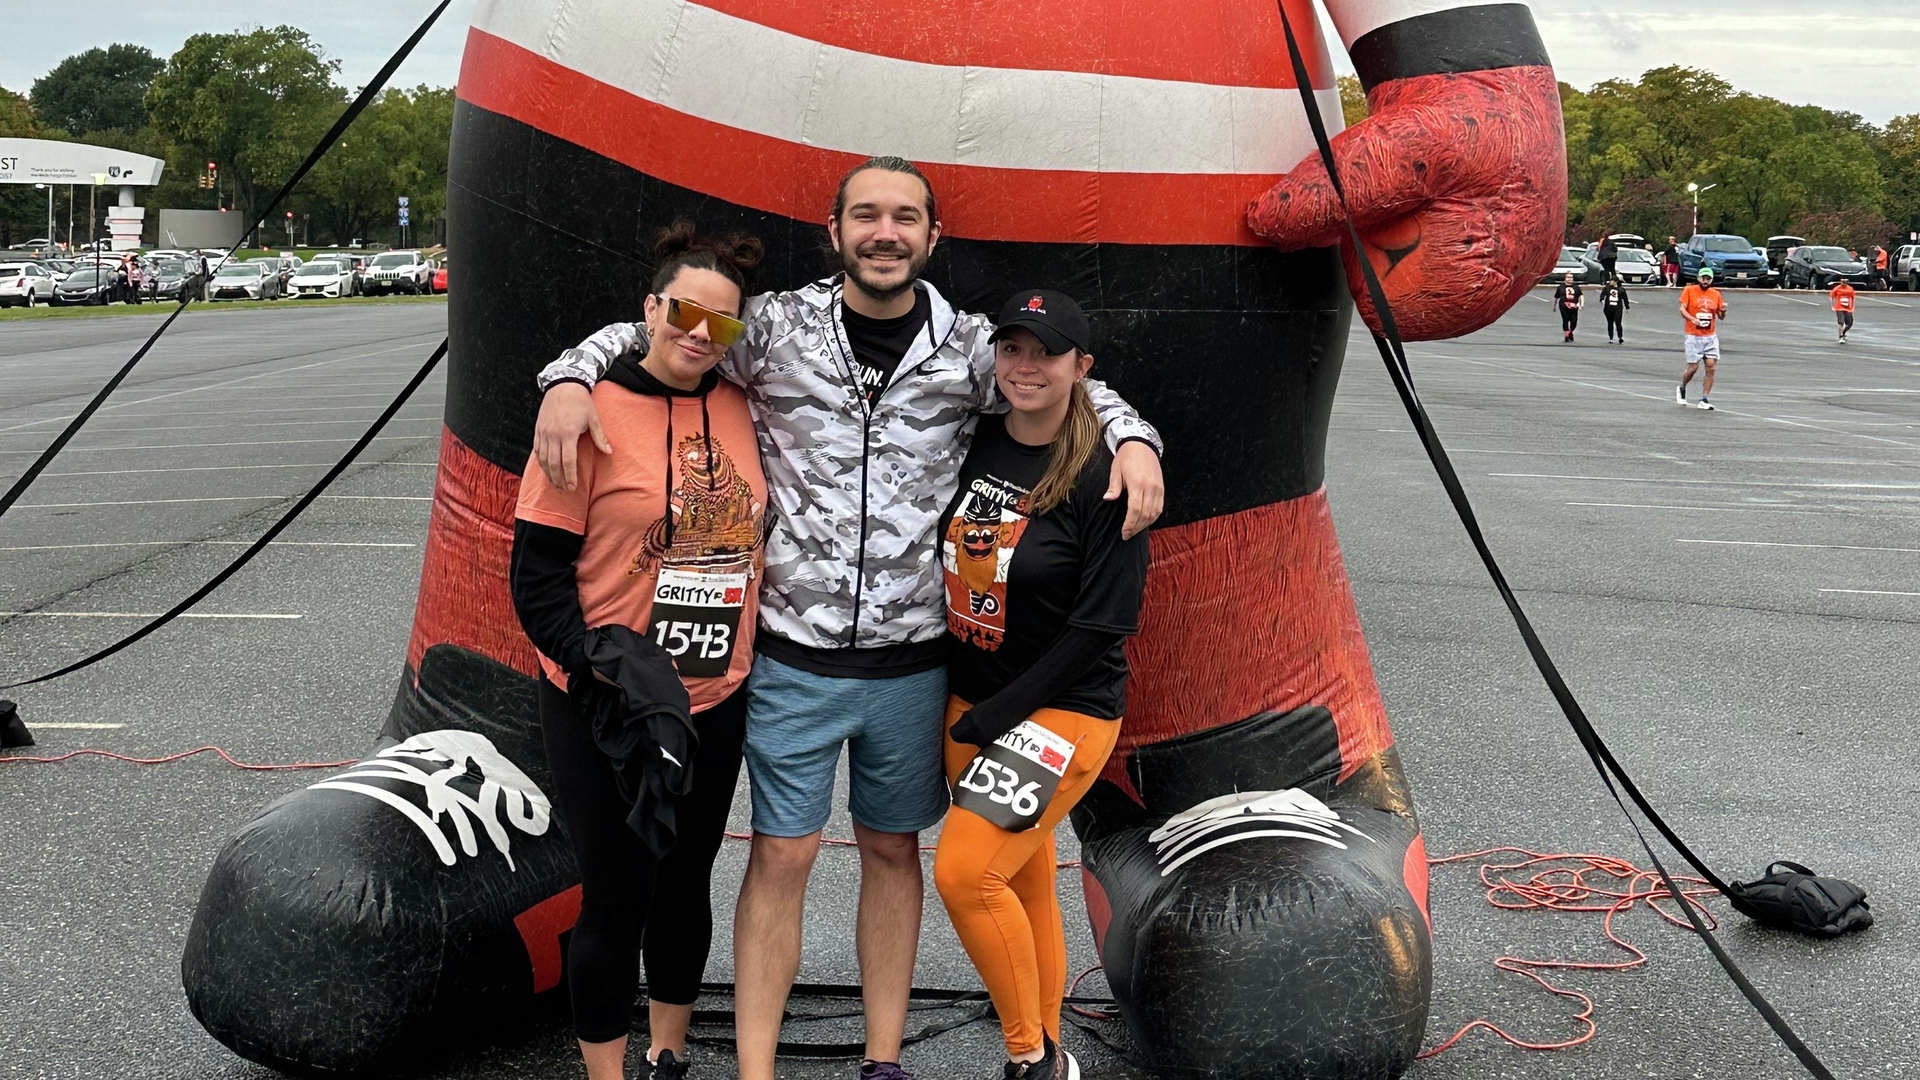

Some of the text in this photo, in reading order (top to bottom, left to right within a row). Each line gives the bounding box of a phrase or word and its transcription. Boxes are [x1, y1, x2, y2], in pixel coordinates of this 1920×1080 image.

[971, 478, 1013, 507] GRITTY
[657, 585, 716, 604] GRITTY
[655, 620, 731, 659] 1543
[959, 756, 1042, 817] 1536
